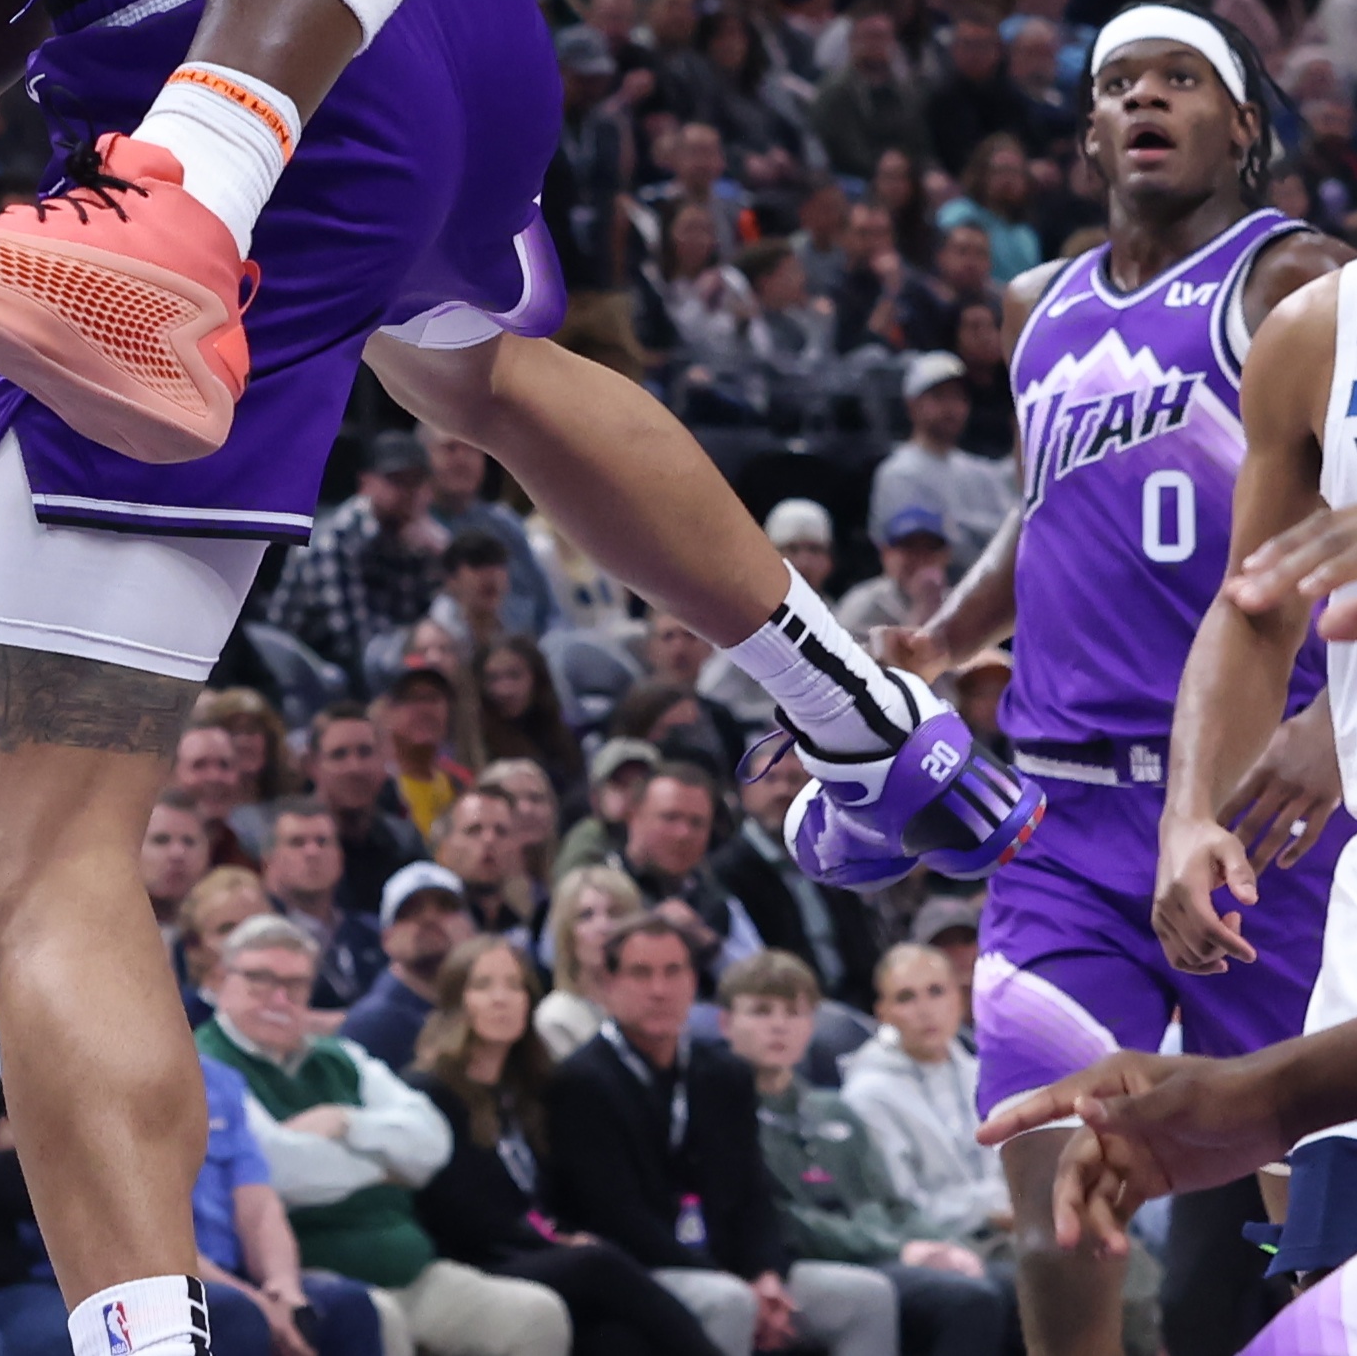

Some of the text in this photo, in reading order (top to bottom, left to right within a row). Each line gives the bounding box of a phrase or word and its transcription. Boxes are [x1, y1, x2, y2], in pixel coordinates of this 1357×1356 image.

[1022, 371, 1207, 523] UTAH
[1142, 469, 1196, 563] 0
[920, 739, 961, 784] 20
